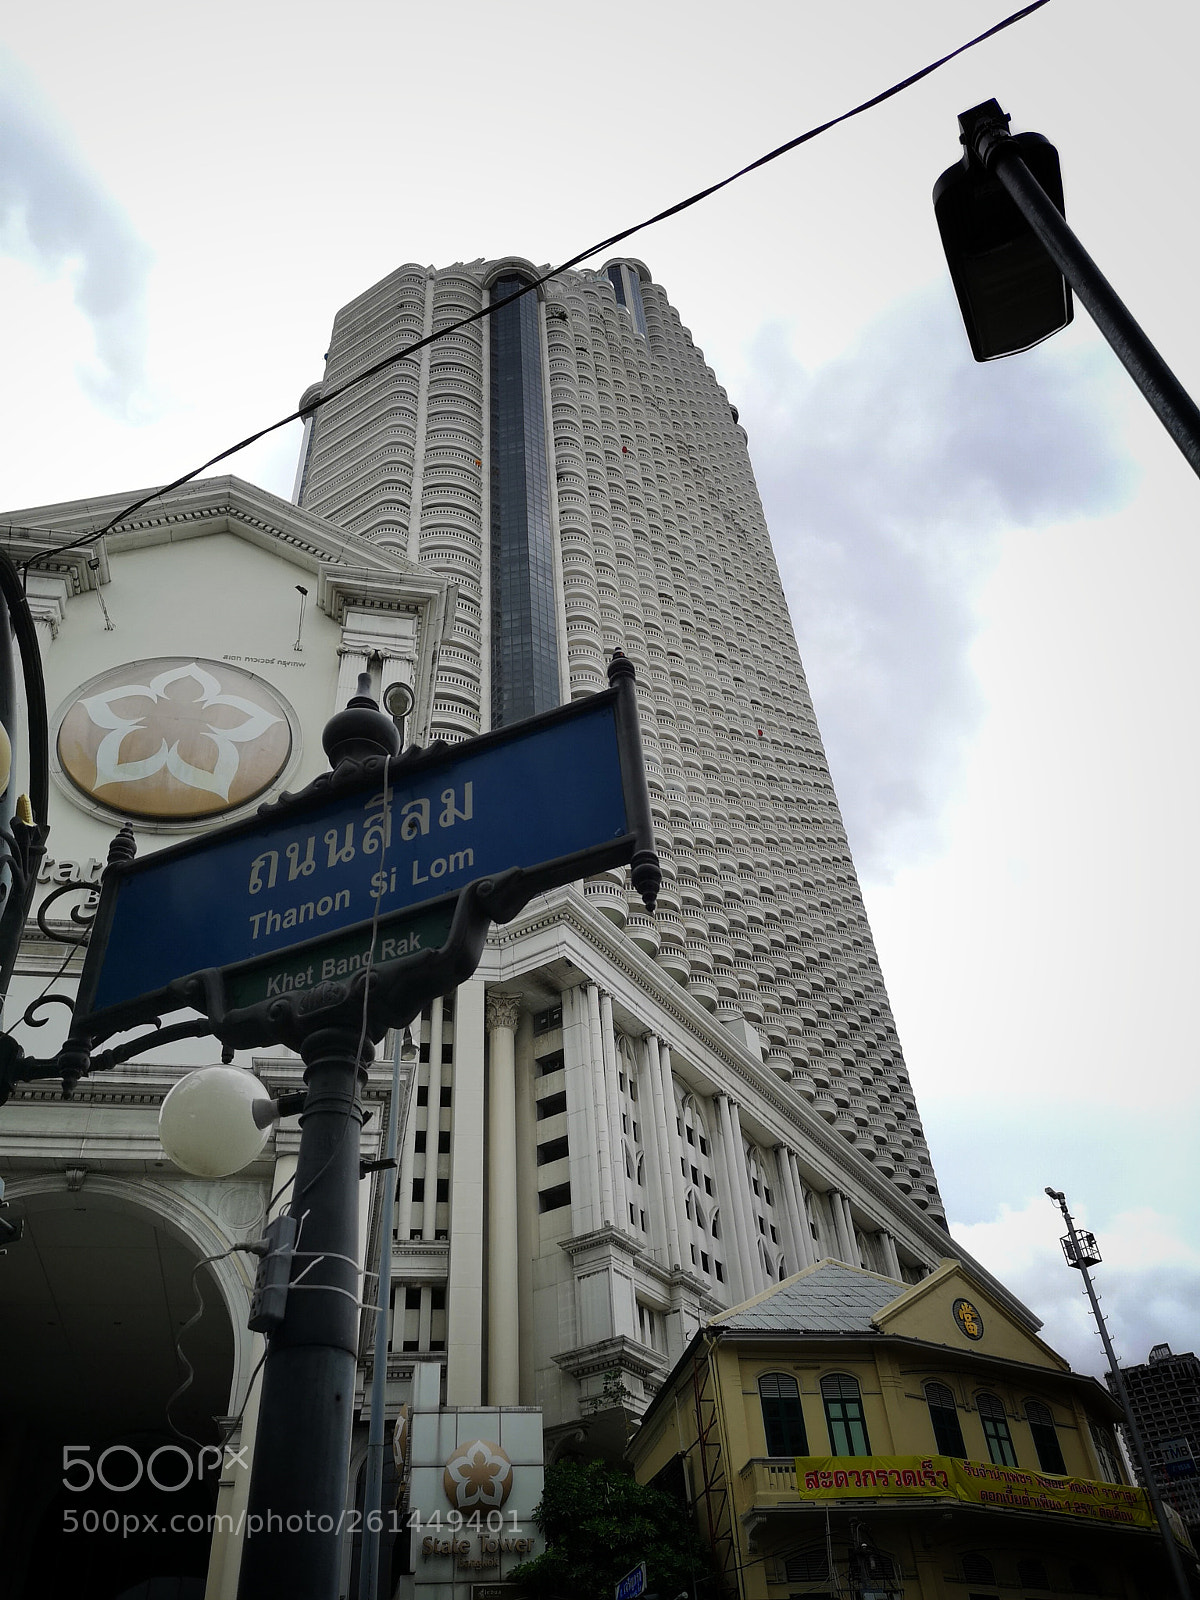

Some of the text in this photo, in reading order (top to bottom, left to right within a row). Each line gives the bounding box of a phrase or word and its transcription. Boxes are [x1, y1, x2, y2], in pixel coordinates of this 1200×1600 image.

[248, 781, 474, 895] ถนนสีลม
[36, 855, 103, 885] tat
[249, 848, 474, 940] Thanon Si Lom
[266, 967, 314, 998] Khet
[381, 931, 422, 961] Rak
[1161, 1446, 1190, 1461] TMB
[804, 1459, 950, 1490] สะดวกรวดเร็ว
[1063, 1500, 1097, 1517] 1.25%
[421, 1533, 535, 1556] State Tower
